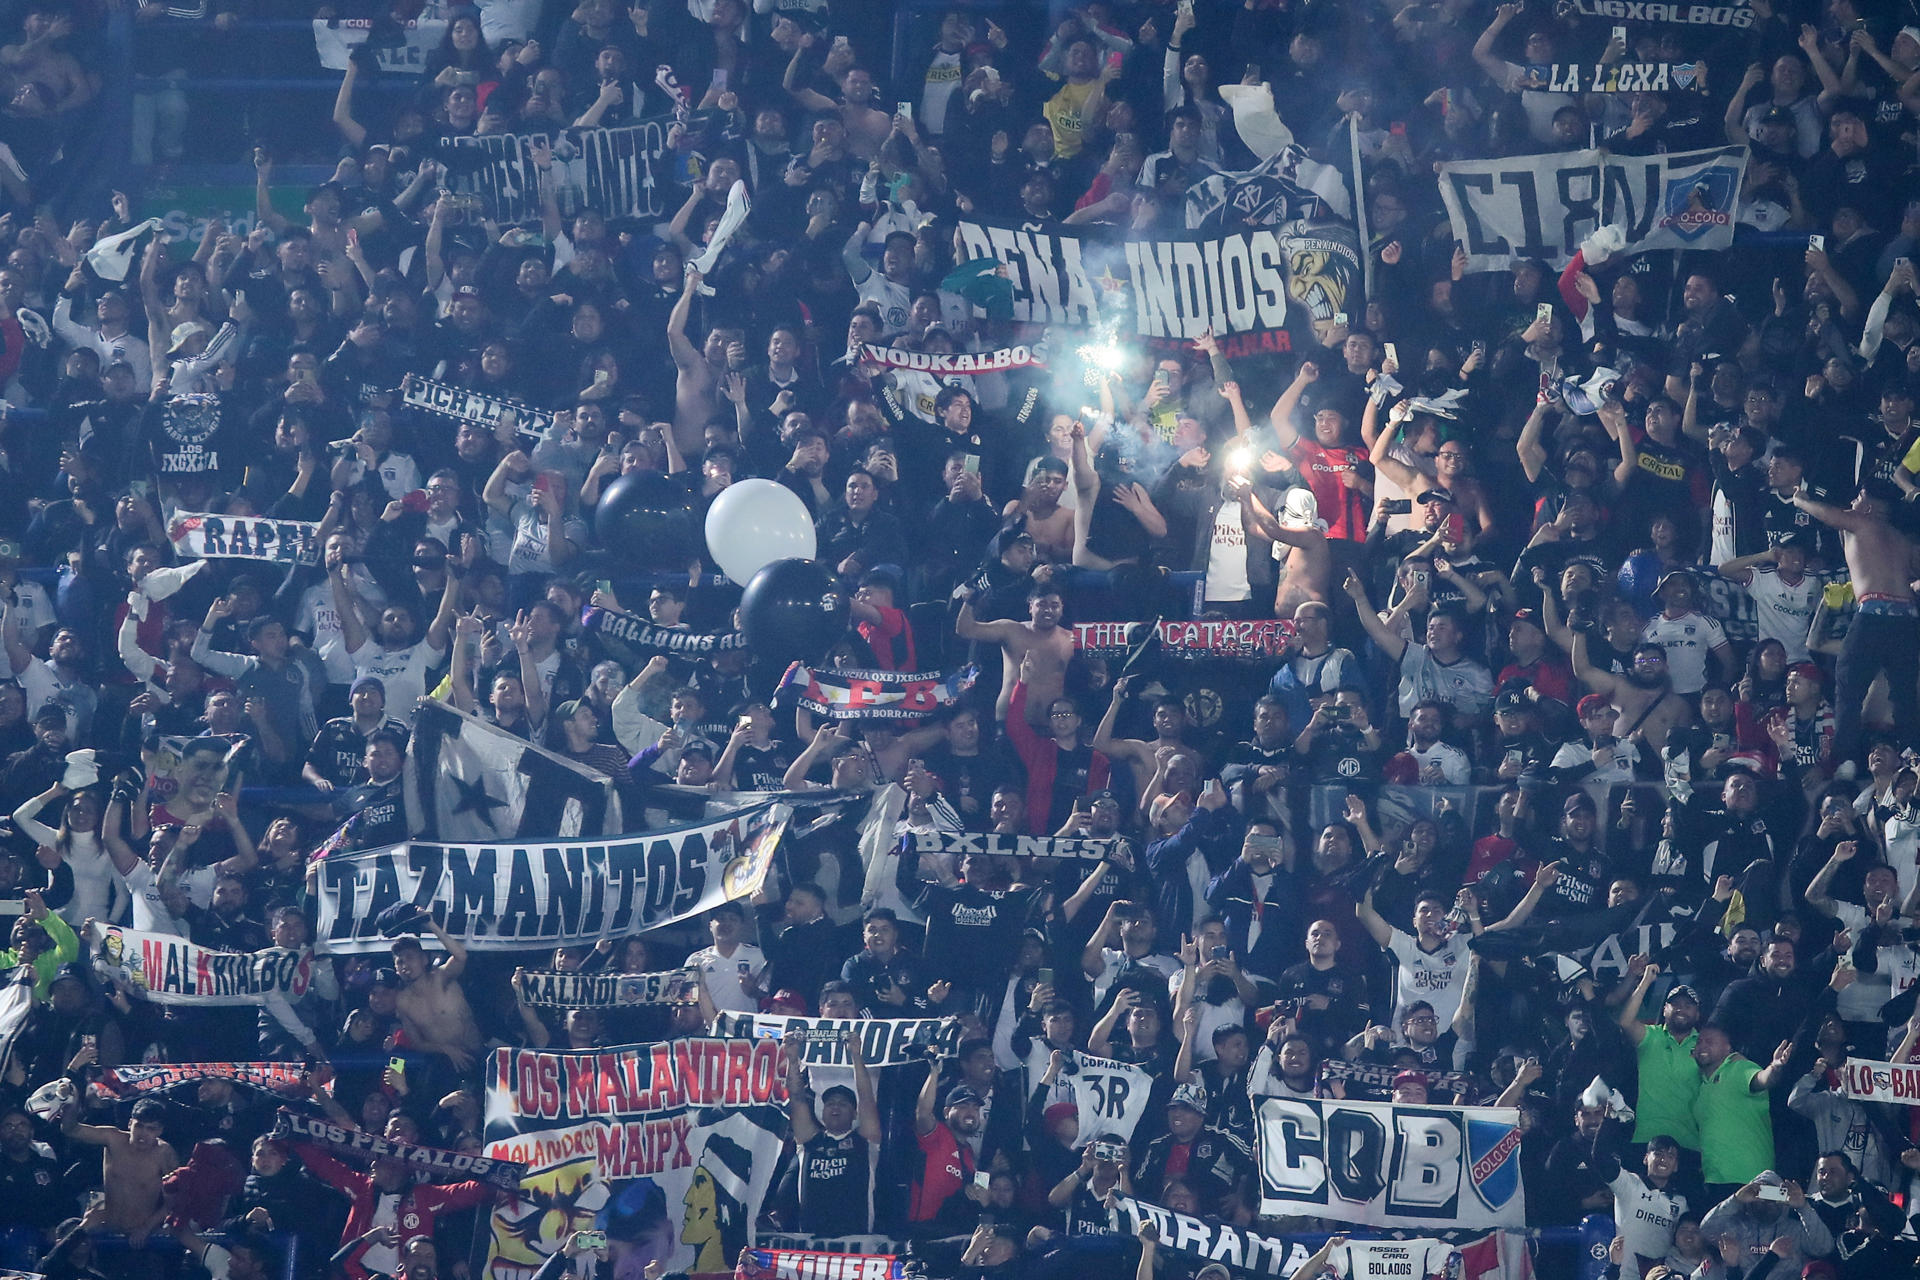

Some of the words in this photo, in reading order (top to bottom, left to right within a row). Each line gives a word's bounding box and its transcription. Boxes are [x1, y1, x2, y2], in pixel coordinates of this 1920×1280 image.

[1549, 63, 1579, 92] LA
[959, 221, 1099, 325] PEÑA
[1124, 230, 1287, 340] INDIOS
[864, 343, 1048, 372] VODKALBOS
[871, 672, 894, 682] QXE
[798, 697, 828, 715] LOCOS
[915, 831, 1106, 861] BXLNES
[320, 831, 710, 944] TAZMANITOS
[498, 1047, 560, 1119] LOS
[563, 1037, 791, 1117] MALANDROS
[1082, 1074, 1130, 1120] 3R
[292, 1112, 347, 1143] LOS
[597, 1112, 694, 1179] MAIPX
[1635, 1208, 1675, 1230] DIRECT
[1368, 1262, 1412, 1276] BOLADOS
